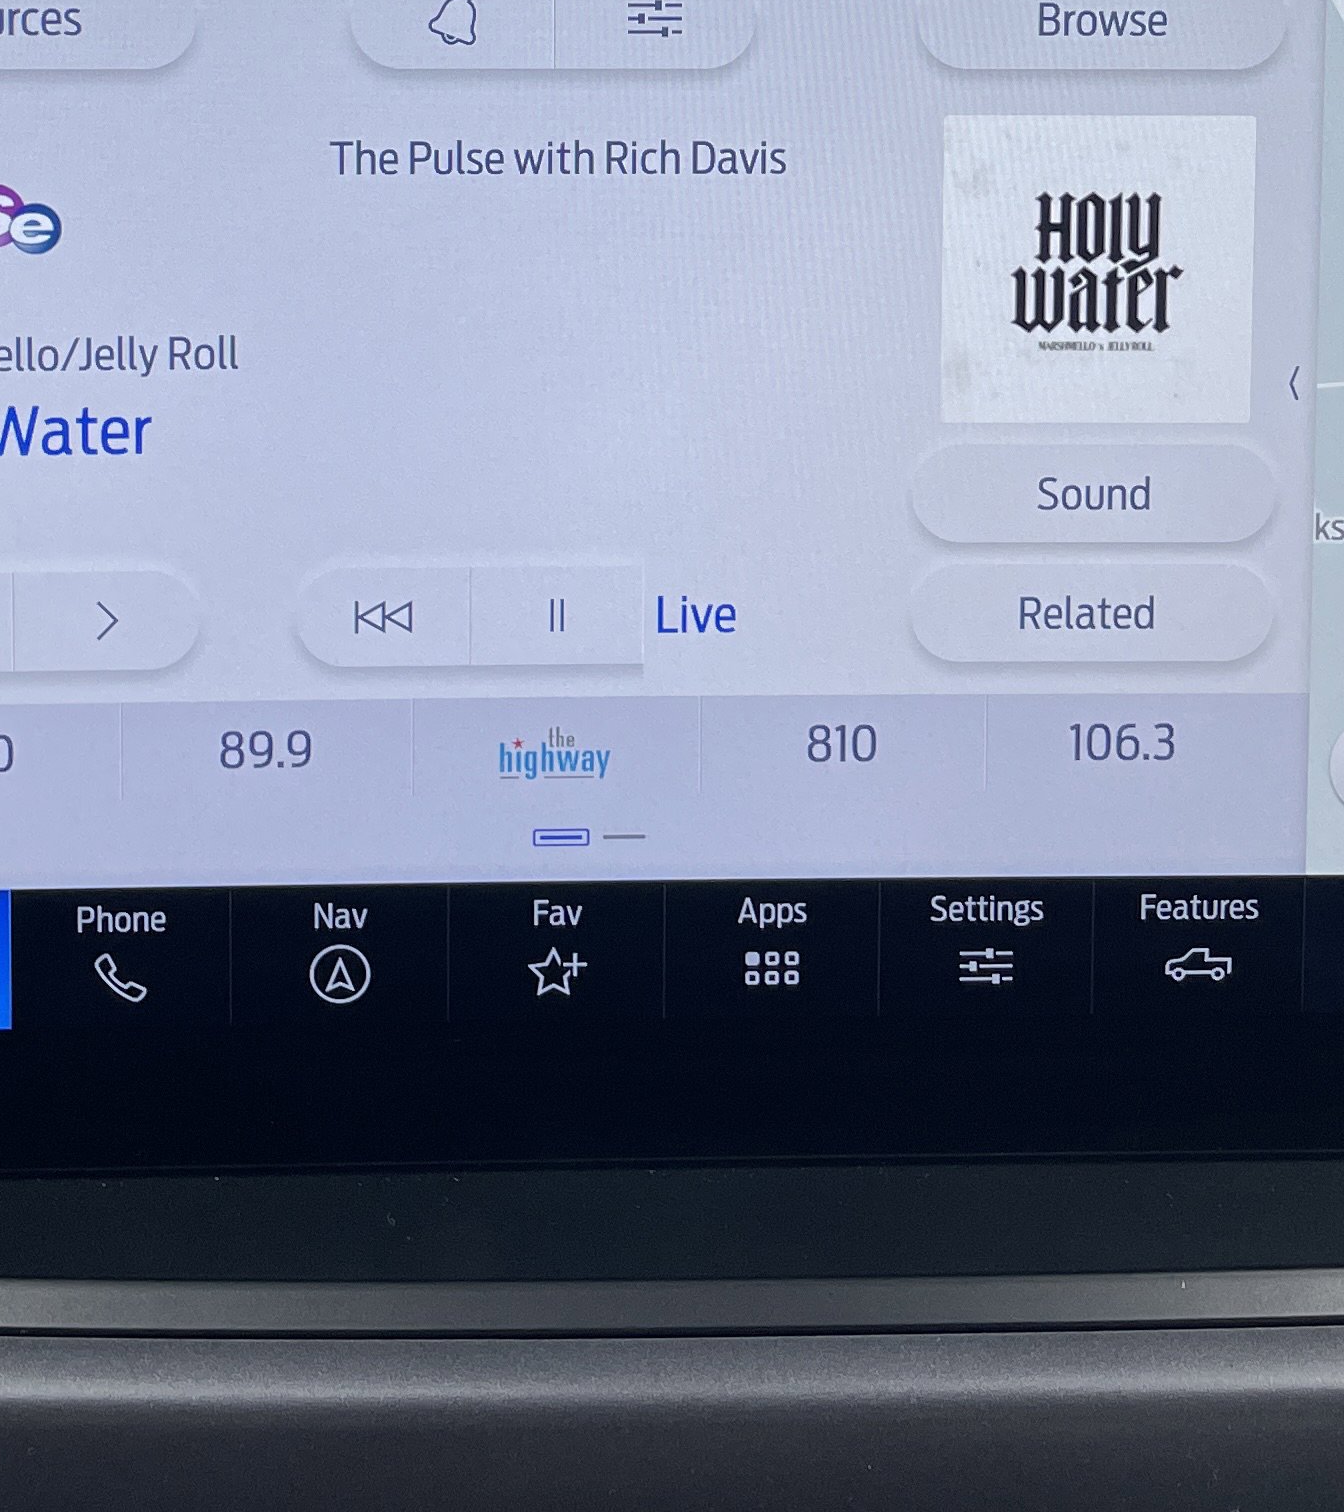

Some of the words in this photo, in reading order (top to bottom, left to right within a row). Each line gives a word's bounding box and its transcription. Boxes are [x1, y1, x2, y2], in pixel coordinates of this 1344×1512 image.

[1038, 2, 1168, 37] Browse
[329, 139, 399, 176] The
[409, 139, 505, 176] Pulse
[513, 139, 595, 175] with
[606, 139, 681, 175] Rich
[692, 140, 787, 175] Davis
[169, 334, 239, 371] Roll
[1037, 475, 1151, 511] Sound
[657, 595, 736, 634] Live
[1019, 595, 1155, 630] Related
[220, 729, 312, 769] 89.9
[549, 726, 575, 748] the
[807, 724, 877, 763] 810
[1069, 722, 1175, 761] 106.3
[499, 738, 611, 780] highway
[77, 904, 167, 934] Phone
[313, 902, 368, 930] Nav
[533, 899, 583, 927] Fav
[737, 896, 808, 929] Apps
[930, 894, 1044, 927] Settings
[1140, 893, 1259, 921] Features
